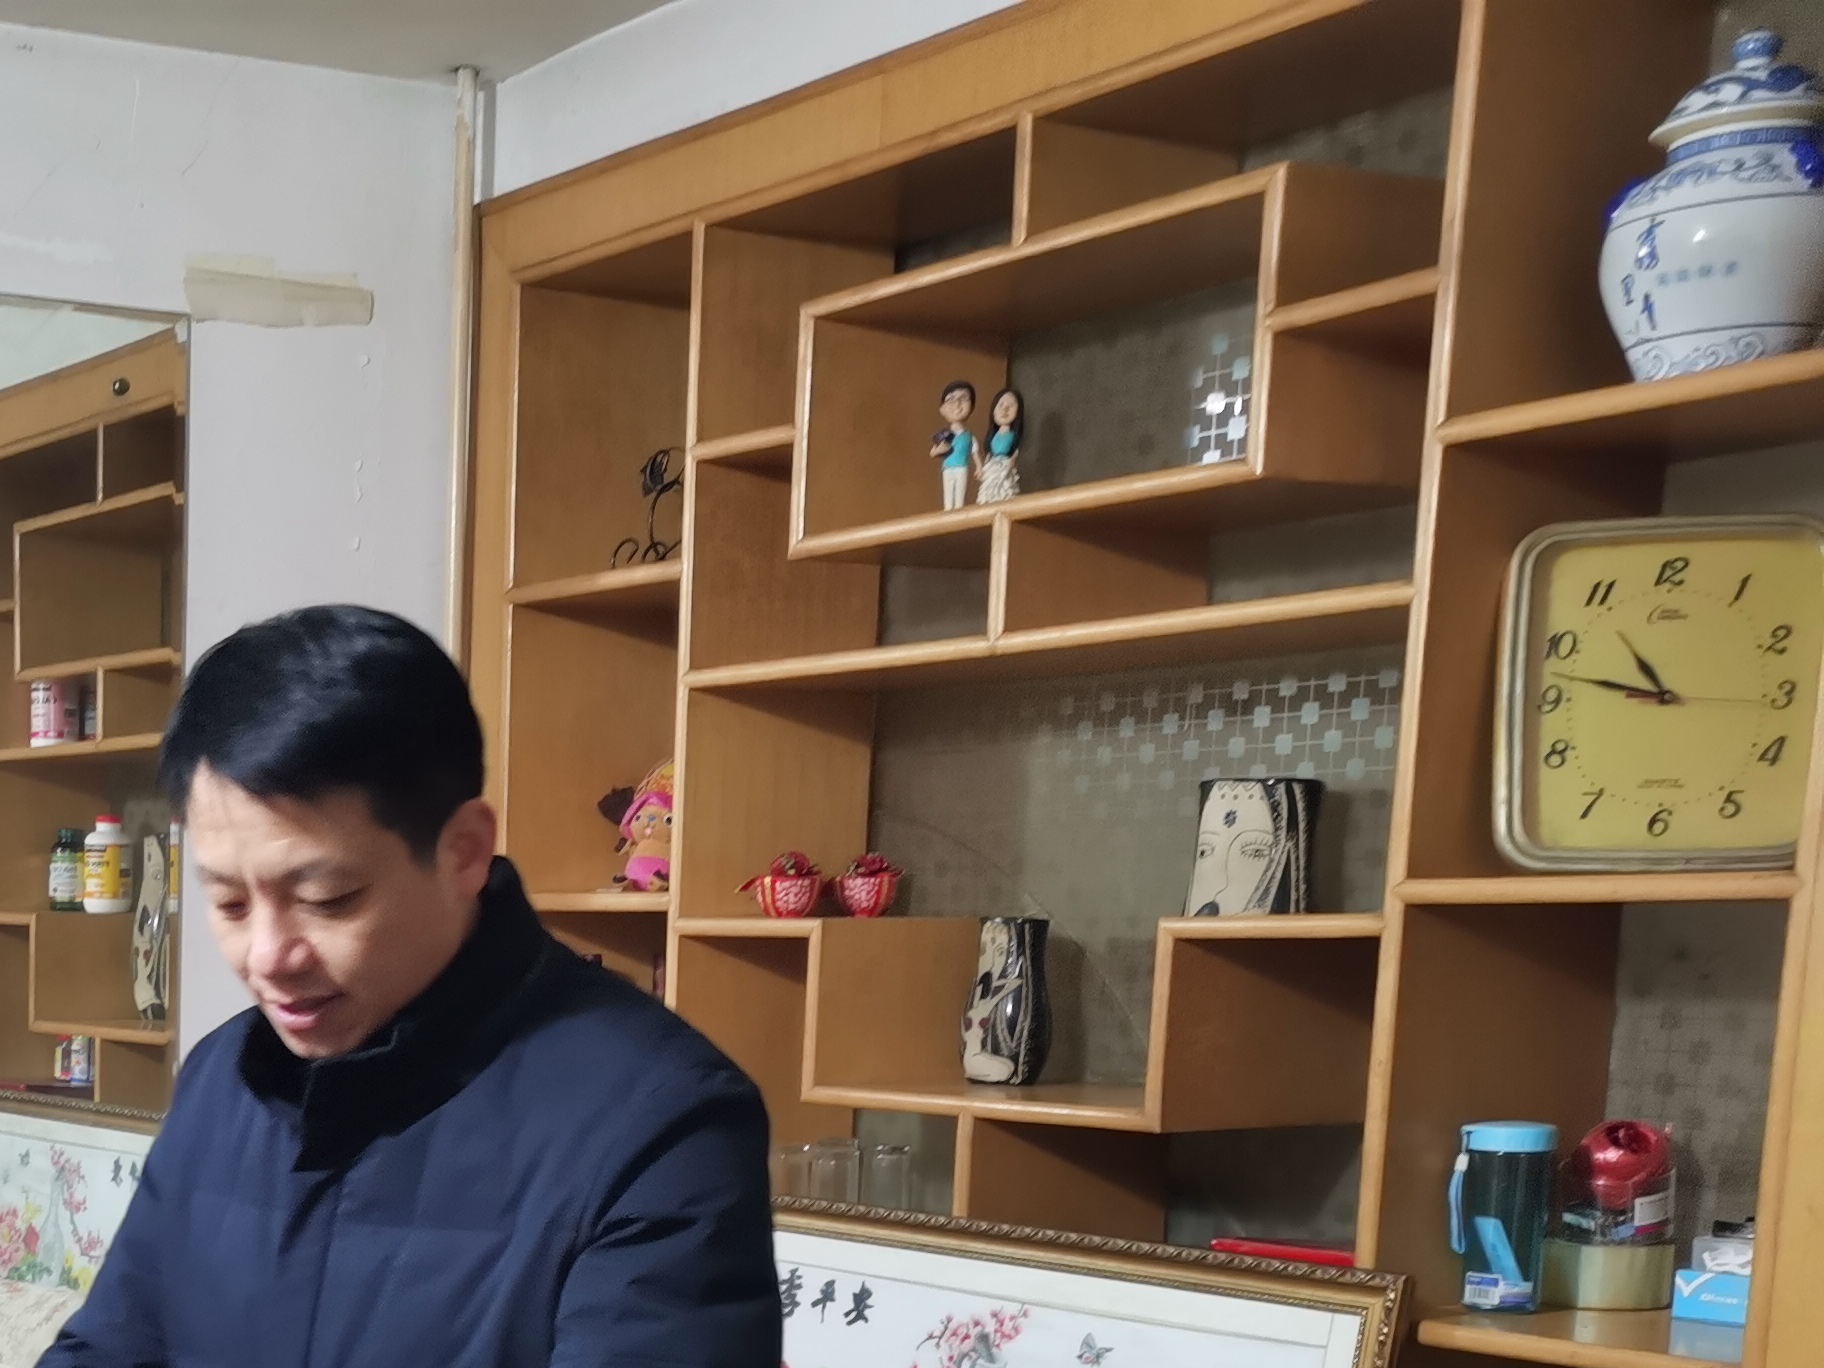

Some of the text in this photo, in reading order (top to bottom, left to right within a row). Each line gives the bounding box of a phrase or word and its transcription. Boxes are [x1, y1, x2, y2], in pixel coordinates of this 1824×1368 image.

[1655, 557, 1690, 587] 12
[1583, 578, 1618, 607] 11
[1731, 574, 1753, 605] 1
[1544, 630, 1578, 660] 10
[1763, 625, 1793, 655] 2
[1537, 684, 1564, 714] 9
[1770, 679, 1797, 710] 3
[1543, 738, 1570, 769] 8
[1757, 735, 1788, 767] 4
[1578, 787, 1605, 820] 7
[1717, 789, 1745, 819] 5
[1646, 808, 1673, 837] 6
